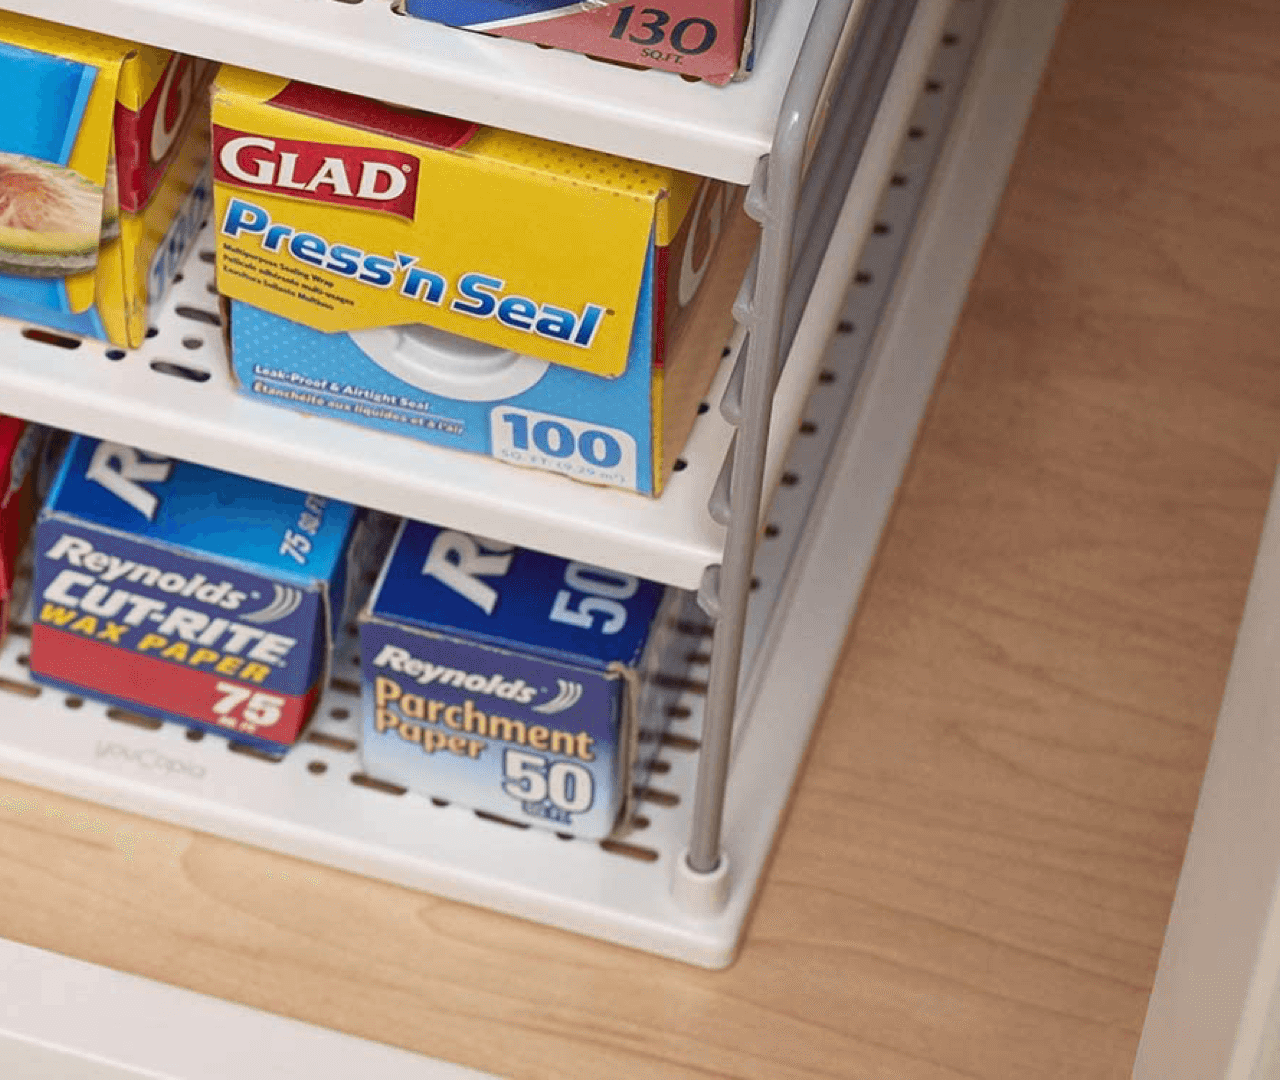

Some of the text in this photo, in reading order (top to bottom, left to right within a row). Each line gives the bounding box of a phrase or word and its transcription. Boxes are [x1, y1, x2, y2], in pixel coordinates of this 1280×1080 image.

[609, 4, 718, 57] 130
[220, 137, 410, 201] GLAD
[222, 196, 608, 350] Press'n Seal
[253, 363, 328, 389] Leak-Proof
[502, 412, 622, 469] 100
[45, 534, 248, 611] Reynolds
[279, 529, 313, 565] 75
[44, 569, 297, 664] CUT-RITE
[549, 561, 640, 635] 50
[40, 603, 272, 684] WAX PAPER
[373, 644, 537, 704] Reynolds
[212, 681, 286, 726] 75
[374, 676, 595, 762] Parchment
[376, 709, 485, 762] Paper
[502, 748, 595, 815] 50
